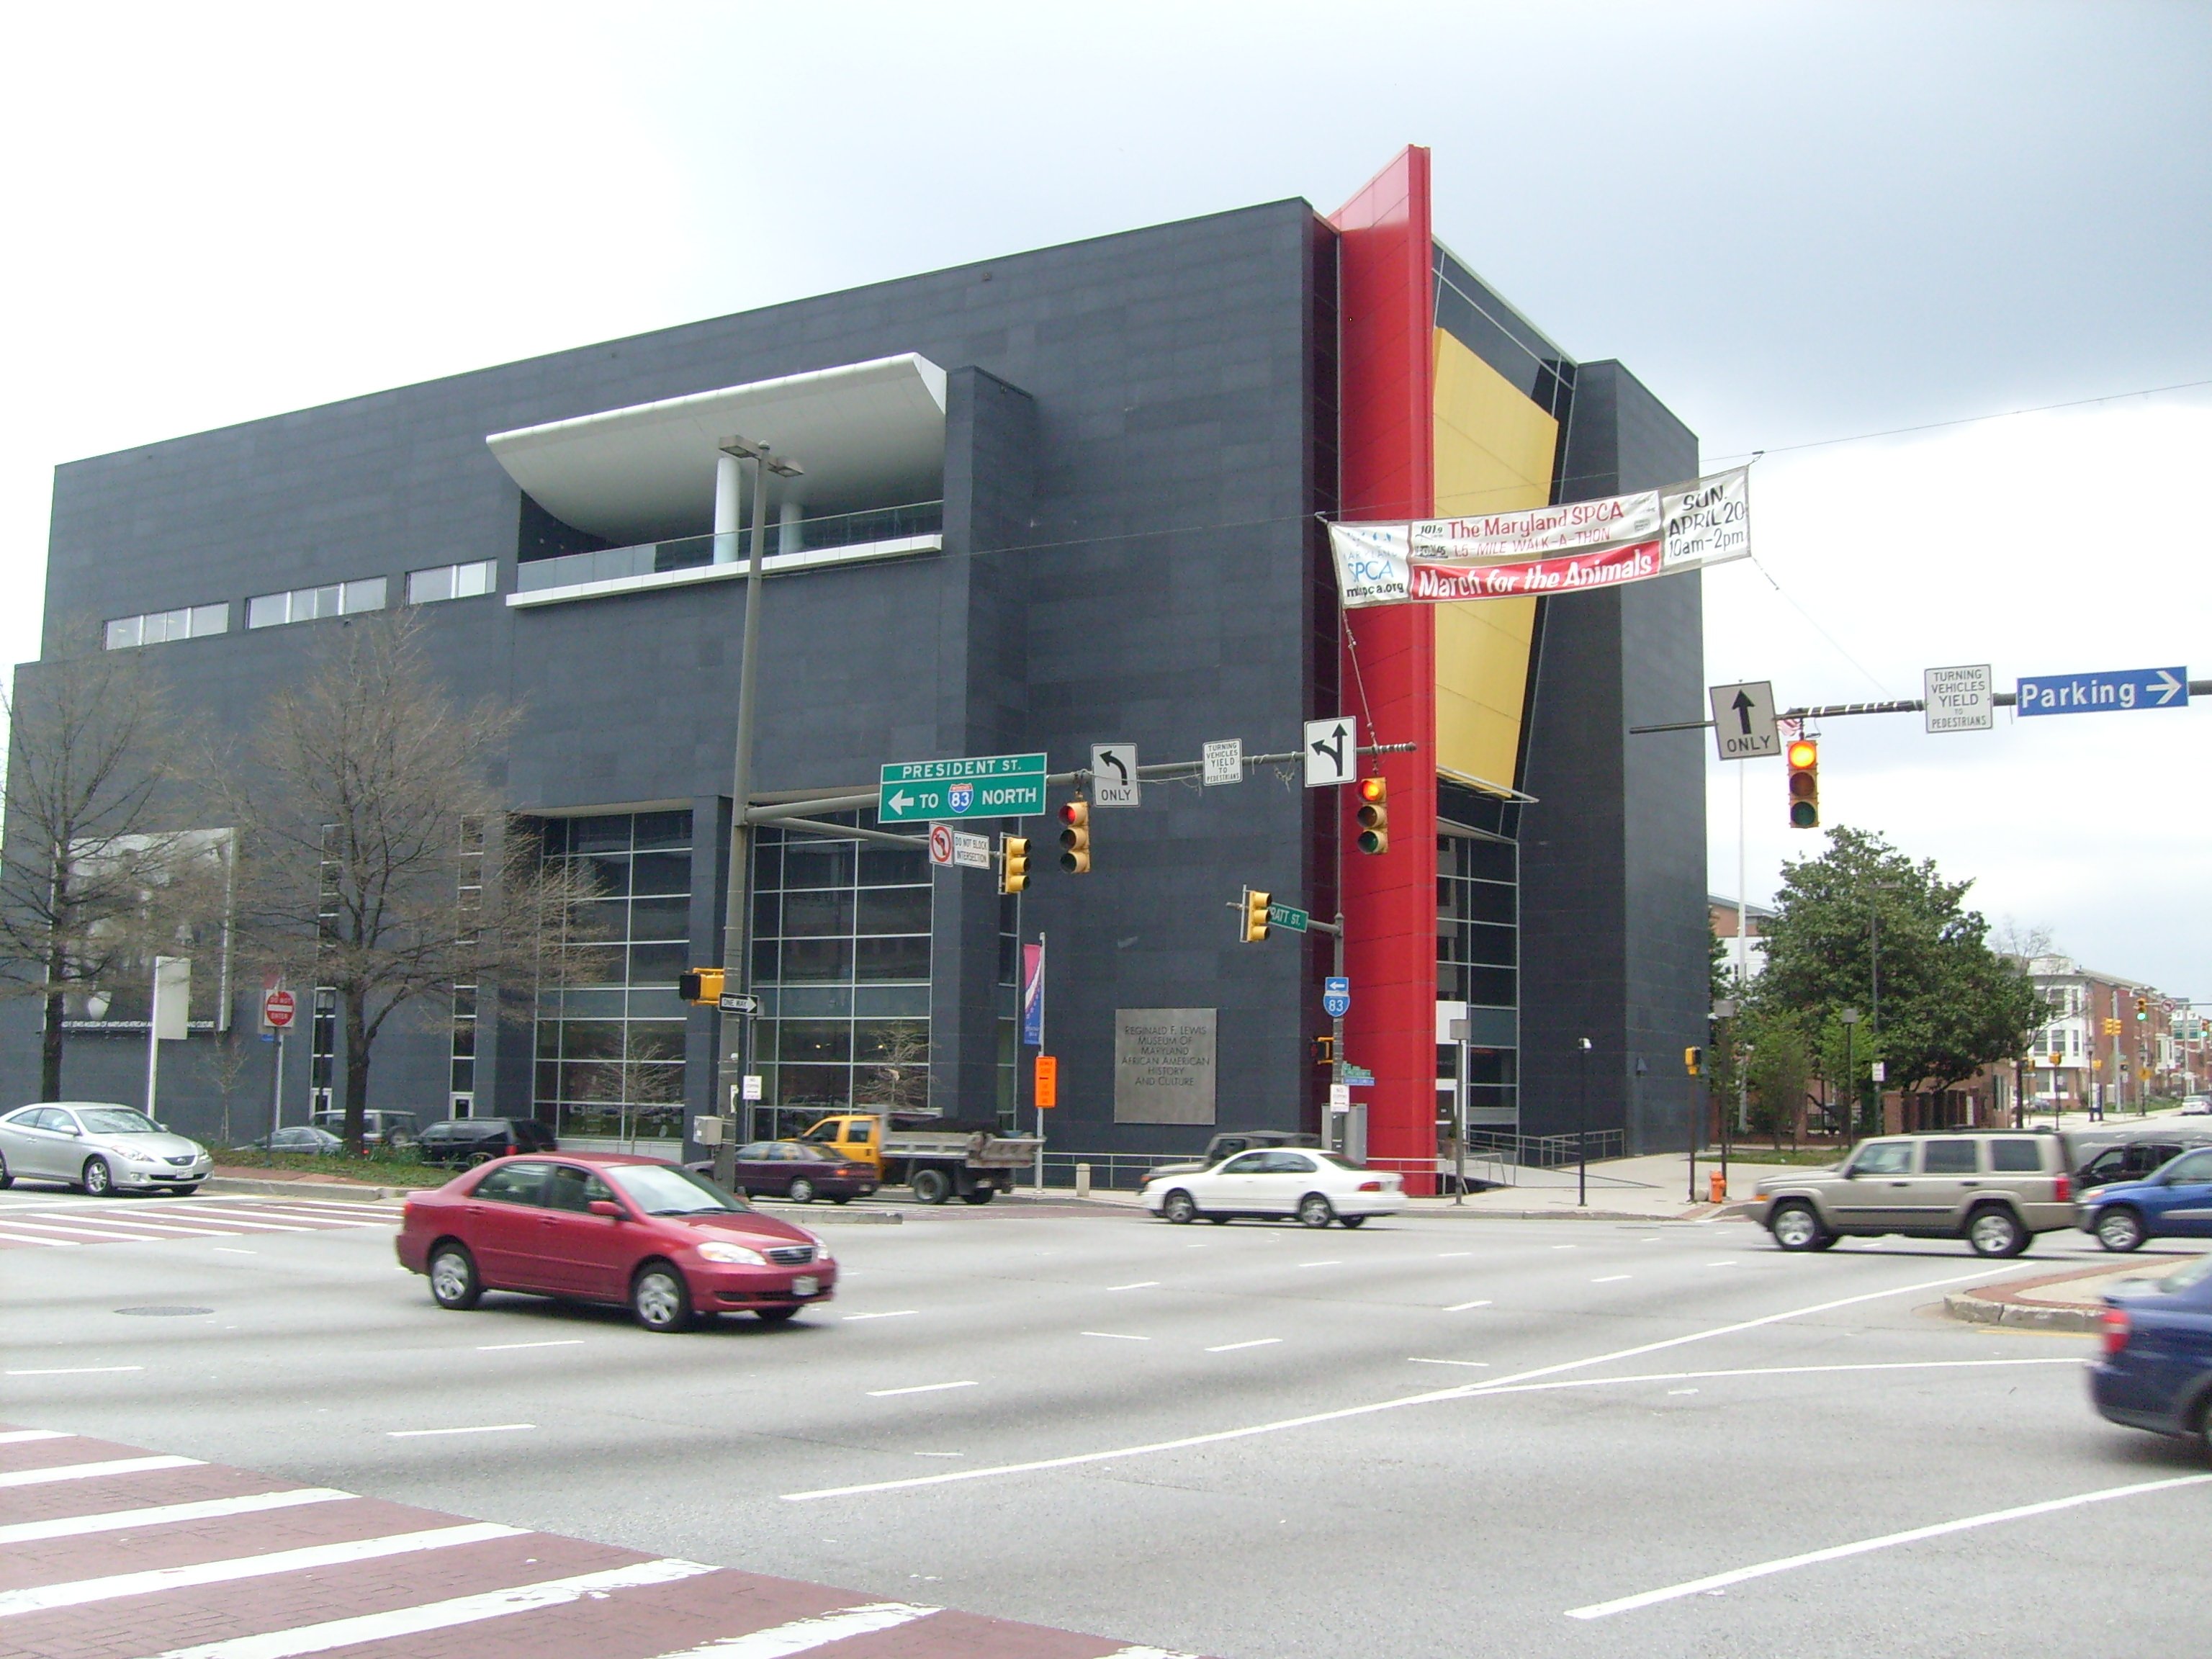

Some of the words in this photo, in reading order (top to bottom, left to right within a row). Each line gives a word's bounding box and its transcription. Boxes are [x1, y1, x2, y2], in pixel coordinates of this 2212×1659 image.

[1682, 485, 1727, 511] SUN.
[1448, 520, 1480, 539] The
[1485, 508, 1568, 538] Maryland
[1571, 501, 1624, 525] SPCA
[1669, 512, 1722, 538] APRIL
[1723, 500, 1745, 524] 20
[1513, 528, 1611, 552] WALK-A-THON
[1669, 528, 1744, 558] 10am-2pm
[1348, 560, 1394, 583] SPCA
[1418, 570, 1483, 597] March
[1485, 568, 1521, 593] for
[1524, 565, 1560, 589] the
[1561, 549, 1653, 587] Animals
[1933, 669, 1982, 682] TURNING
[1931, 681, 1986, 695] VEHICLES
[2021, 679, 2136, 709] Parking
[1938, 693, 1979, 707] YIELD
[1931, 716, 1987, 729] PEDESTRIANS
[1208, 742, 1238, 751] TURNING
[1727, 734, 1771, 753] ONLY
[1206, 750, 1238, 760] VEHICLES
[1210, 757, 1236, 767] YIELD
[902, 760, 997, 779] PRESIDENT
[1002, 760, 1022, 771] ST.
[1207, 772, 1239, 783] PEDESTRIANS
[919, 793, 939, 809] TO
[950, 791, 970, 808] 83
[981, 787, 1037, 806] NORTH
[1100, 788, 1132, 802] ONLY
[955, 836, 963, 846] DO
[963, 838, 972, 848] NOT
[973, 840, 987, 850] BLOCK
[956, 850, 987, 863] INTERSECTION
[1291, 913, 1300, 926] ST.
[723, 998, 734, 1007] ONE
[736, 999, 748, 1008] WAY
[1328, 999, 1344, 1012] 83
[1124, 1026, 1168, 1035] REGINALD
[1170, 1026, 1177, 1035] F.
[1180, 1026, 1208, 1035] LEWIS
[1138, 1035, 1177, 1045] MUSEUM
[1179, 1035, 1192, 1045] OF
[1141, 1047, 1190, 1056] MARYLAND
[1121, 1056, 1159, 1066] AFRICAN
[1162, 1056, 1210, 1066] AMERICAN
[1148, 1066, 1185, 1076] HISTORY
[1135, 1077, 1155, 1086] AND
[1158, 1077, 1195, 1086] CULTURE
